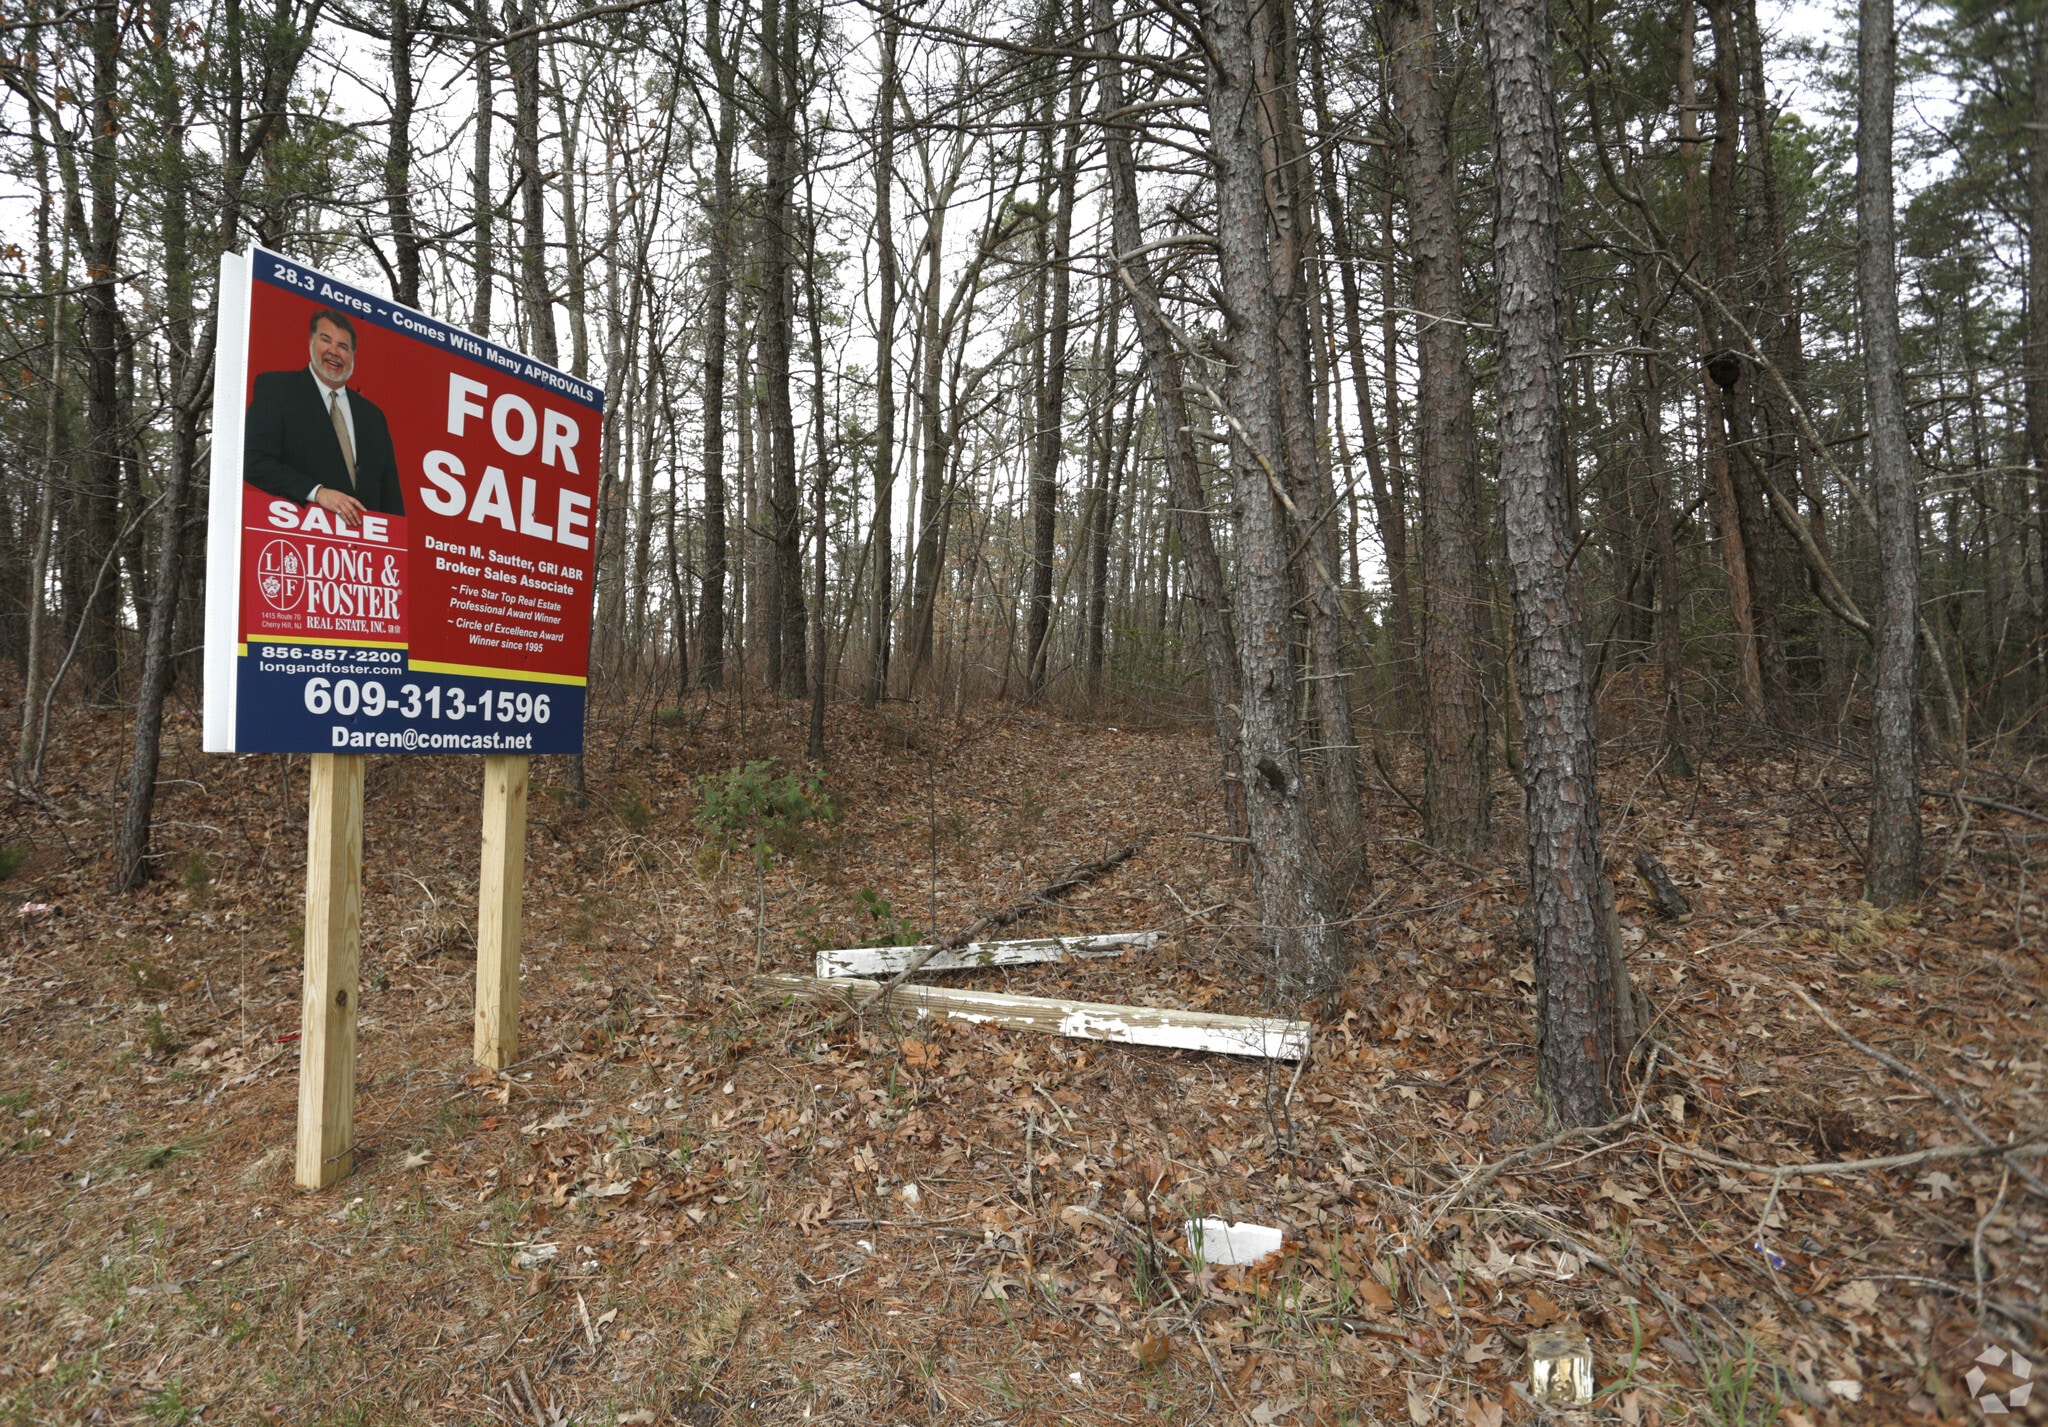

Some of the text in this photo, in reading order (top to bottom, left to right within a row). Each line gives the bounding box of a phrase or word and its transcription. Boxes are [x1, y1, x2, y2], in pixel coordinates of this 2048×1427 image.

[274, 263, 315, 291] 28.3
[320, 283, 372, 314] Acres
[392, 311, 445, 342] Comes
[450, 332, 482, 357] With
[486, 348, 522, 374] Many
[525, 364, 594, 402] APPROVALS
[447, 372, 580, 475] FOR
[419, 449, 591, 550] SALE
[267, 500, 389, 543] SALE
[265, 552, 280, 572] L
[305, 543, 400, 587] LONG &
[425, 535, 583, 581] Daren M. Sautter, GRI ABR
[285, 579, 298, 596] F
[435, 557, 574, 596] Broker Sales Associate
[306, 579, 400, 620] FOSTER
[450, 597, 562, 625] Professional Award Winner
[459, 584, 479, 597] Five
[481, 588, 499, 600] Star
[501, 591, 517, 605] Top
[517, 595, 536, 607] Real
[537, 598, 562, 612] Estate
[261, 612, 302, 621] 1415 Route 70
[261, 621, 281, 630] Cherry
[294, 622, 302, 630] NJ
[306, 615, 387, 634] REAL ESTATE, INC.
[456, 617, 482, 631] Circle
[484, 622, 494, 632] of
[494, 623, 538, 639] Excellence
[539, 630, 565, 642] Award
[261, 646, 401, 663] 856-857-2200
[469, 634, 544, 653] Winner since 1995
[259, 661, 402, 675] longandfoster.com
[304, 677, 551, 724] 609-313-1596
[331, 726, 533, 750] Daren@comcast.net
